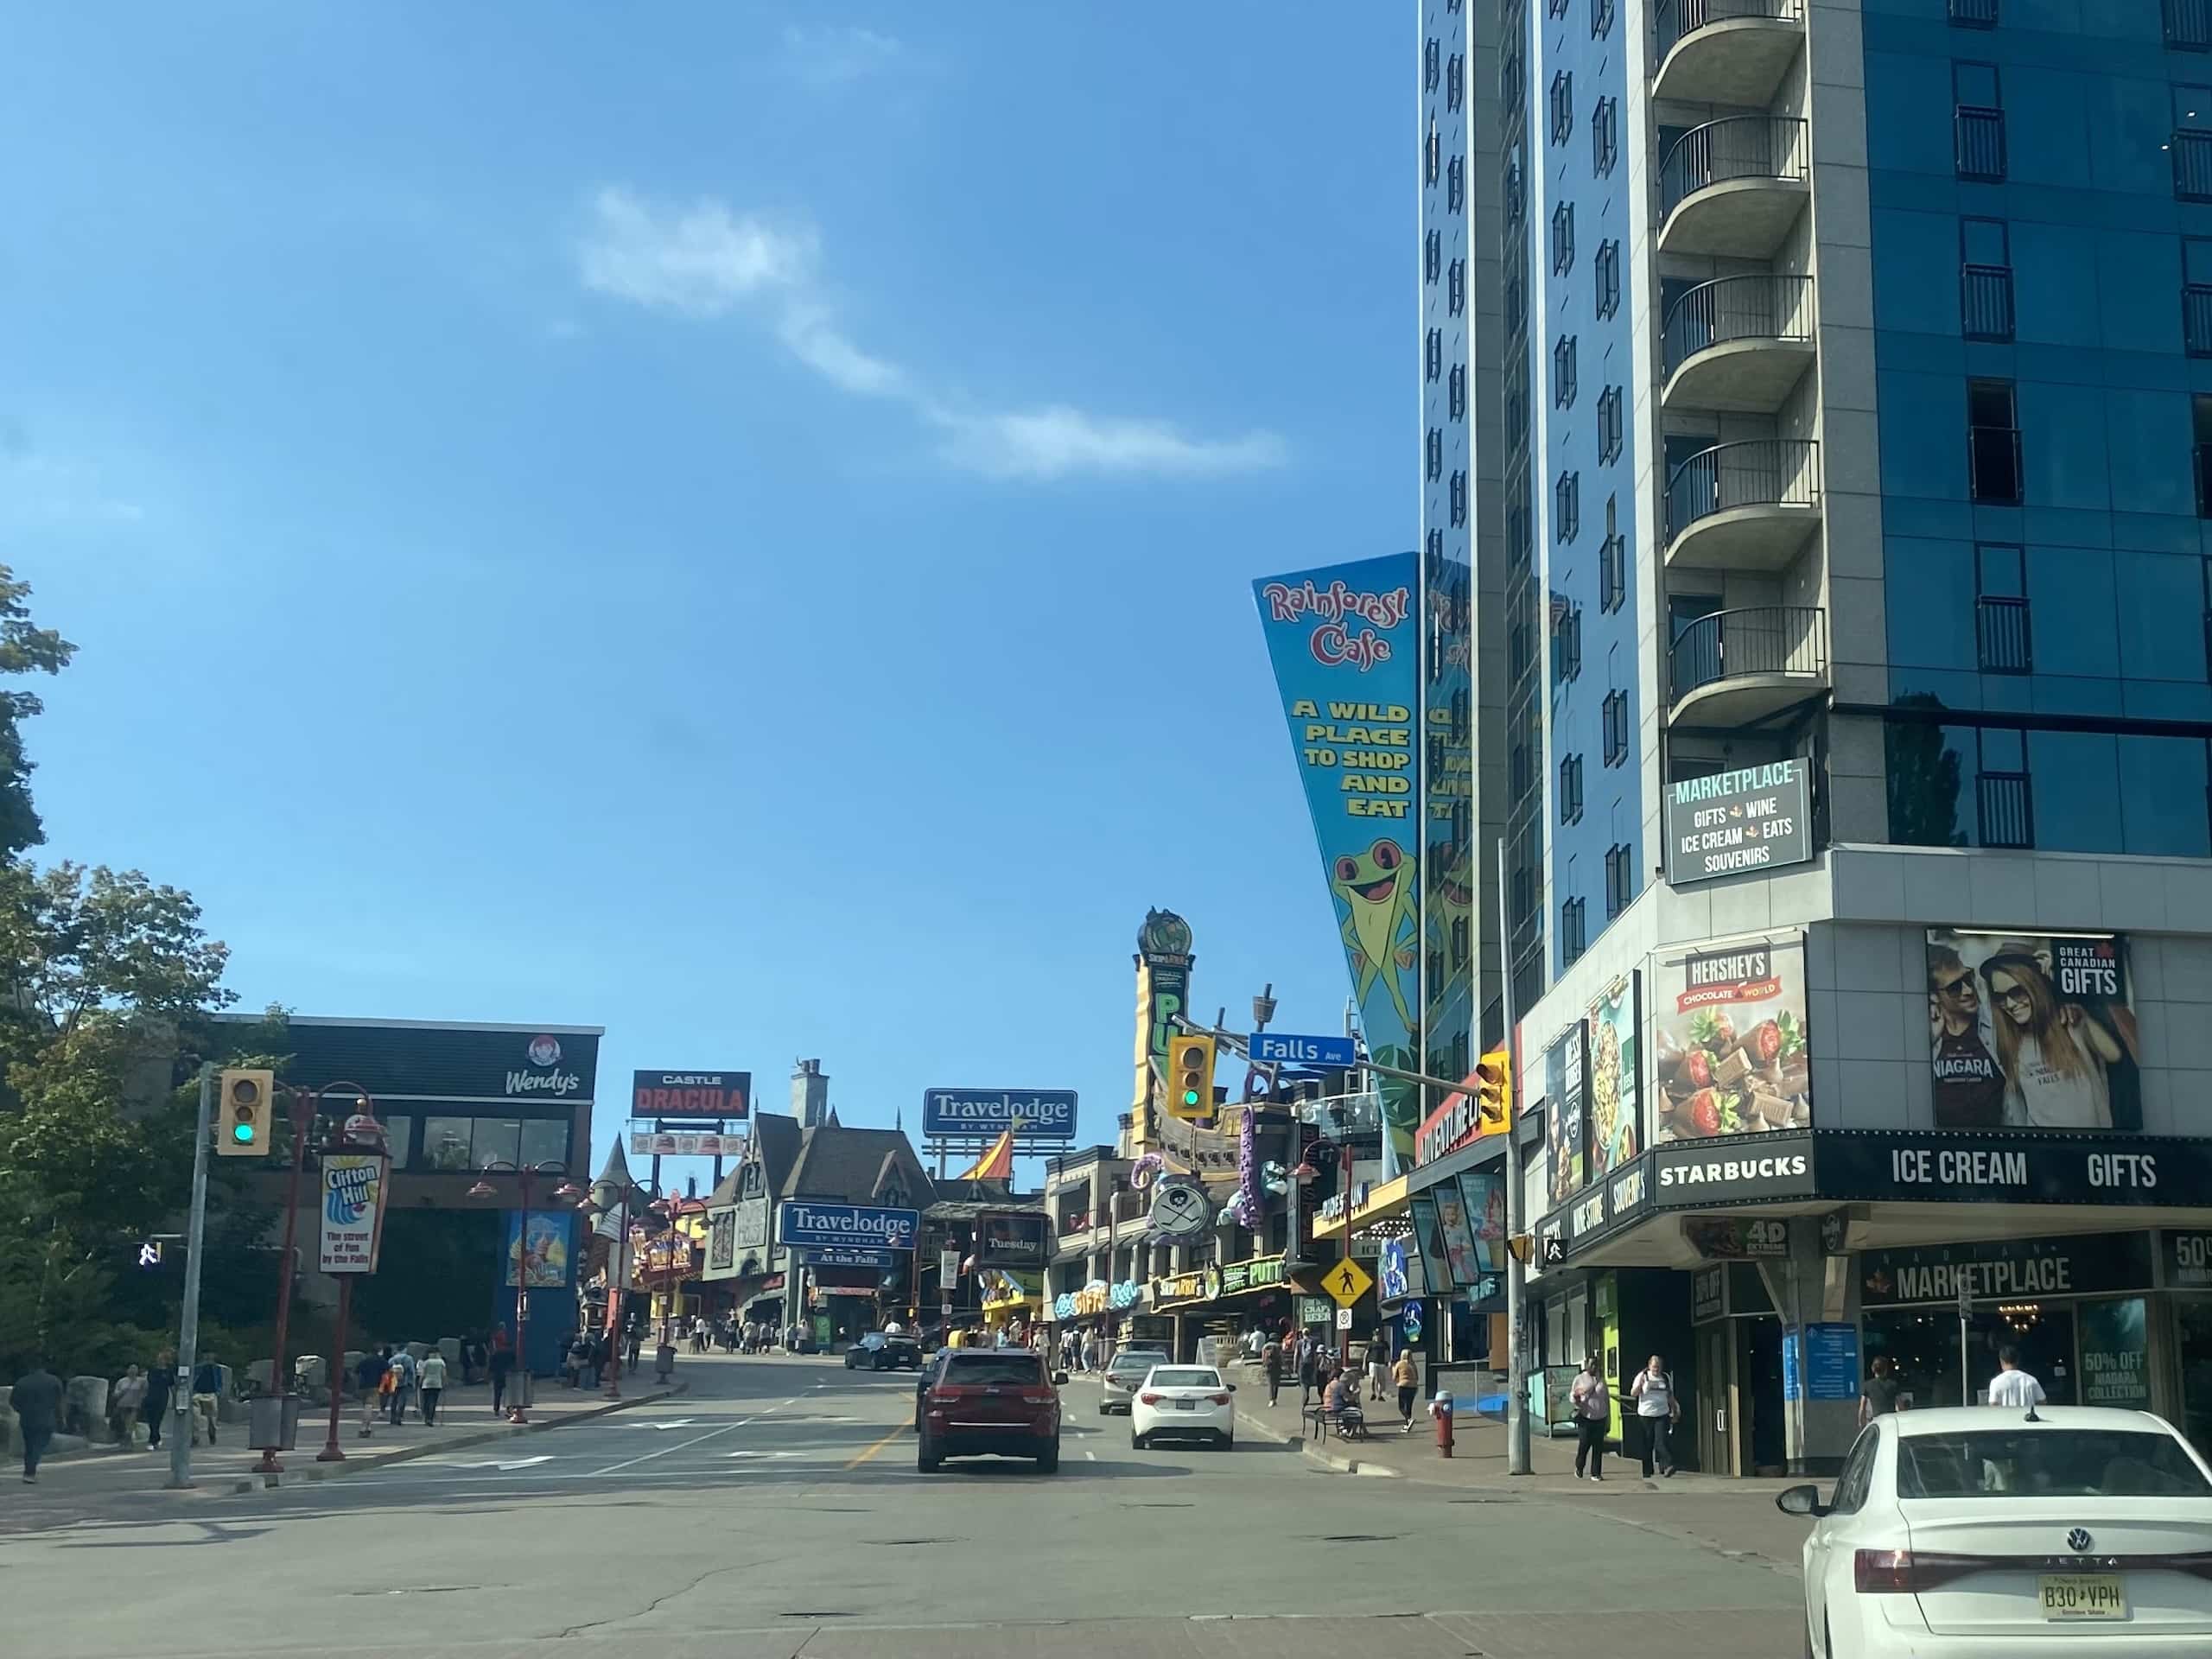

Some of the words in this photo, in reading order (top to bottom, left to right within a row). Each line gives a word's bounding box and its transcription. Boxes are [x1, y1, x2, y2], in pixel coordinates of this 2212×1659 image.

[1263, 580, 1409, 629] Rainforest
[1310, 621, 1391, 672] Cafe
[1293, 699, 1319, 718] A
[1328, 702, 1410, 722] WILD
[1306, 725, 1409, 747] PLACE
[1304, 748, 1337, 766] TO
[1343, 751, 1410, 771] SHOP
[1341, 774, 1409, 793] AND
[1675, 760, 1794, 804] MARKETPLACE
[1348, 798, 1409, 817] EAT
[1694, 807, 1726, 829] GIFTS
[1745, 798, 1777, 818] WINE
[1681, 836, 1700, 854] ICE
[1701, 827, 1743, 849] CREAM
[1763, 817, 1793, 839] EATS
[1705, 846, 1770, 872] SOUVENIRS
[2059, 947, 2094, 957] GREAT
[2060, 957, 2115, 968] CANADIAN
[1692, 952, 1765, 985] HERSHEY'S
[2061, 968, 2117, 995] GIFTS
[1683, 989, 1733, 1006] CHOCOLATE
[1745, 983, 1776, 997] WORLD
[1262, 1039, 1319, 1060] Falls
[1325, 1052, 1341, 1061] Ave
[1934, 1058, 1993, 1077] NIAGARA
[505, 1068, 579, 1096] Wendy's
[662, 1075, 721, 1085] CASTLE
[636, 1088, 743, 1112] DRACULA
[933, 1095, 1068, 1124] Travelodge
[1419, 1095, 1467, 1166] ADVENTURE
[327, 1166, 376, 1189] Clifton
[1660, 1155, 1807, 1186] STARBUCKS
[1892, 1149, 1932, 1182] ICE
[1939, 1151, 2027, 1185] CREAM
[2088, 1154, 2157, 1188] GIFTS
[341, 1185, 369, 1205] Hill
[792, 1208, 910, 1238] Travelodge
[1747, 1221, 1785, 1243] 4D
[327, 1232, 341, 1241] The
[988, 1237, 1037, 1252] Tuesday
[322, 1255, 332, 1264] by
[1249, 1260, 1284, 1285] PUTT
[1897, 1257, 2071, 1299] MARKETPLACE
[2084, 1352, 2117, 1370] 50%
[2120, 1351, 2143, 1370] OFF
[2088, 1384, 2146, 1399] COLLECTION
[2045, 1557, 2118, 1566] JETTA
